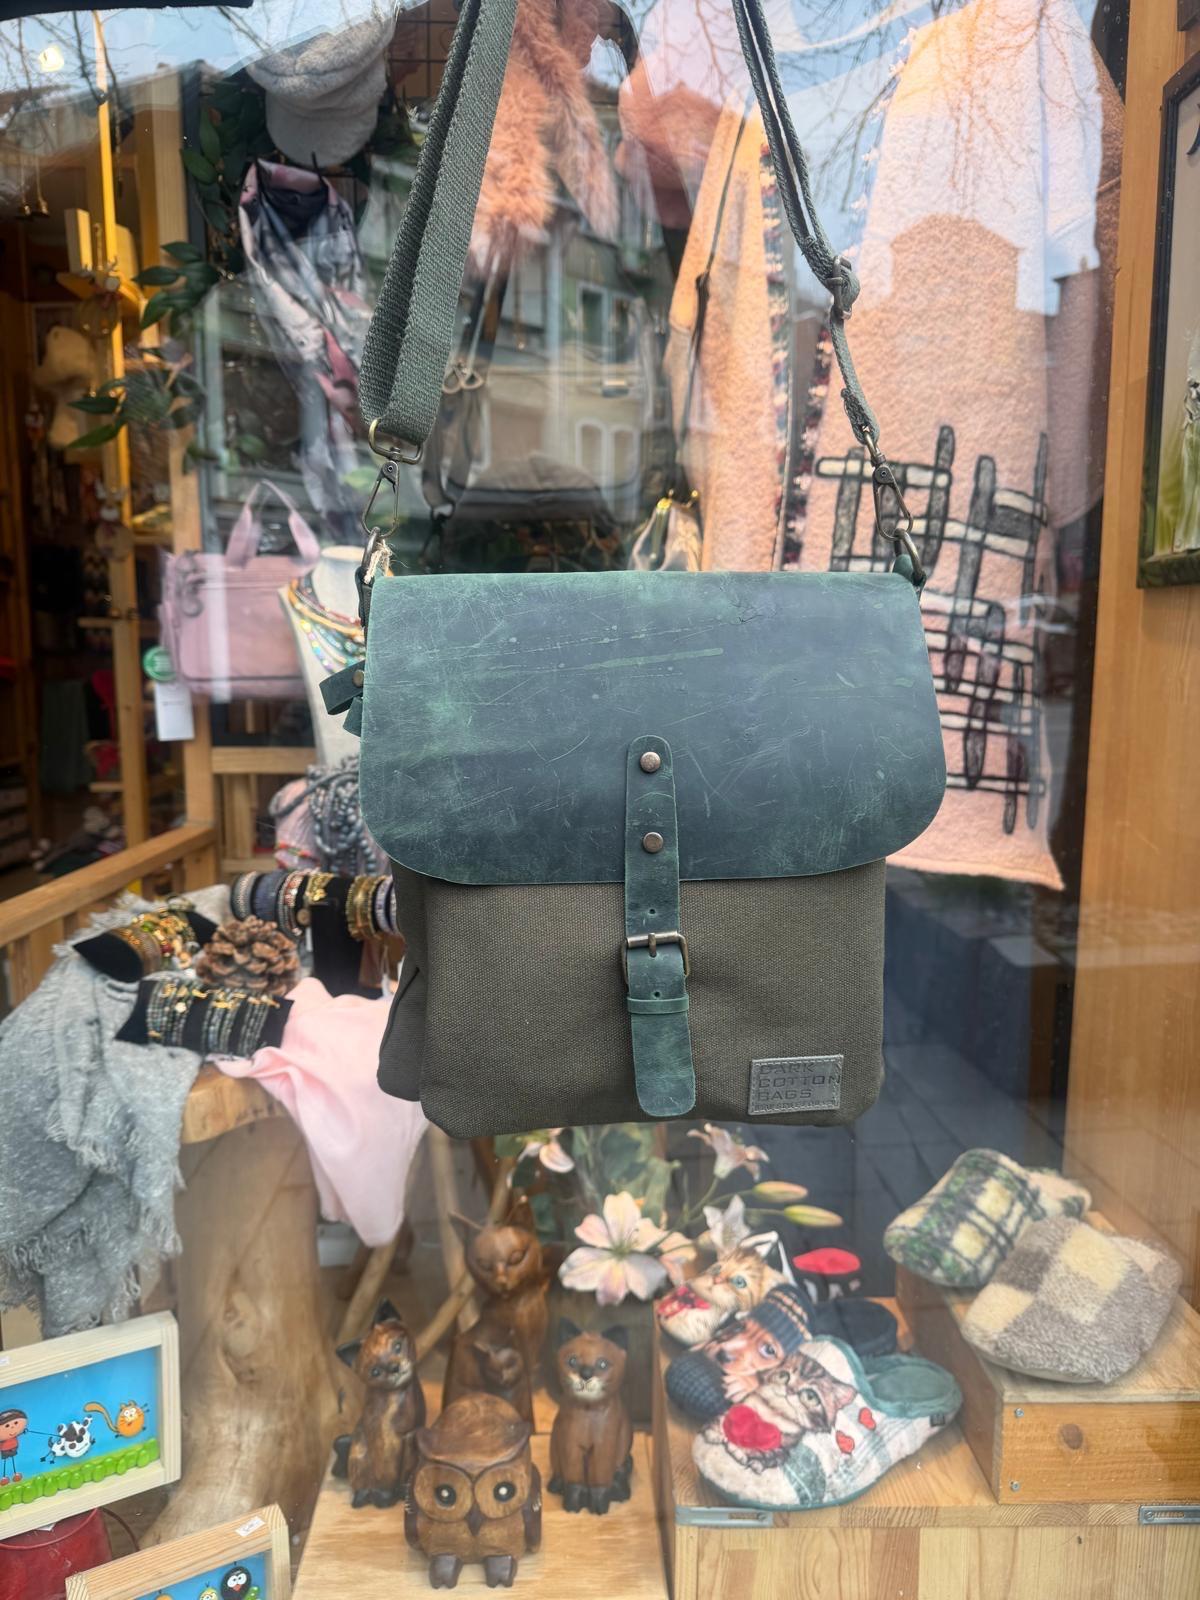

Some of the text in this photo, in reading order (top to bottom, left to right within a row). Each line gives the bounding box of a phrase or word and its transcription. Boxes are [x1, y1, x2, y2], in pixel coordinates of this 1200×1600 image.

[760, 1063, 815, 1075] DARK
[758, 1075, 840, 1088] COTTON
[758, 1089, 812, 1101] BAGS
